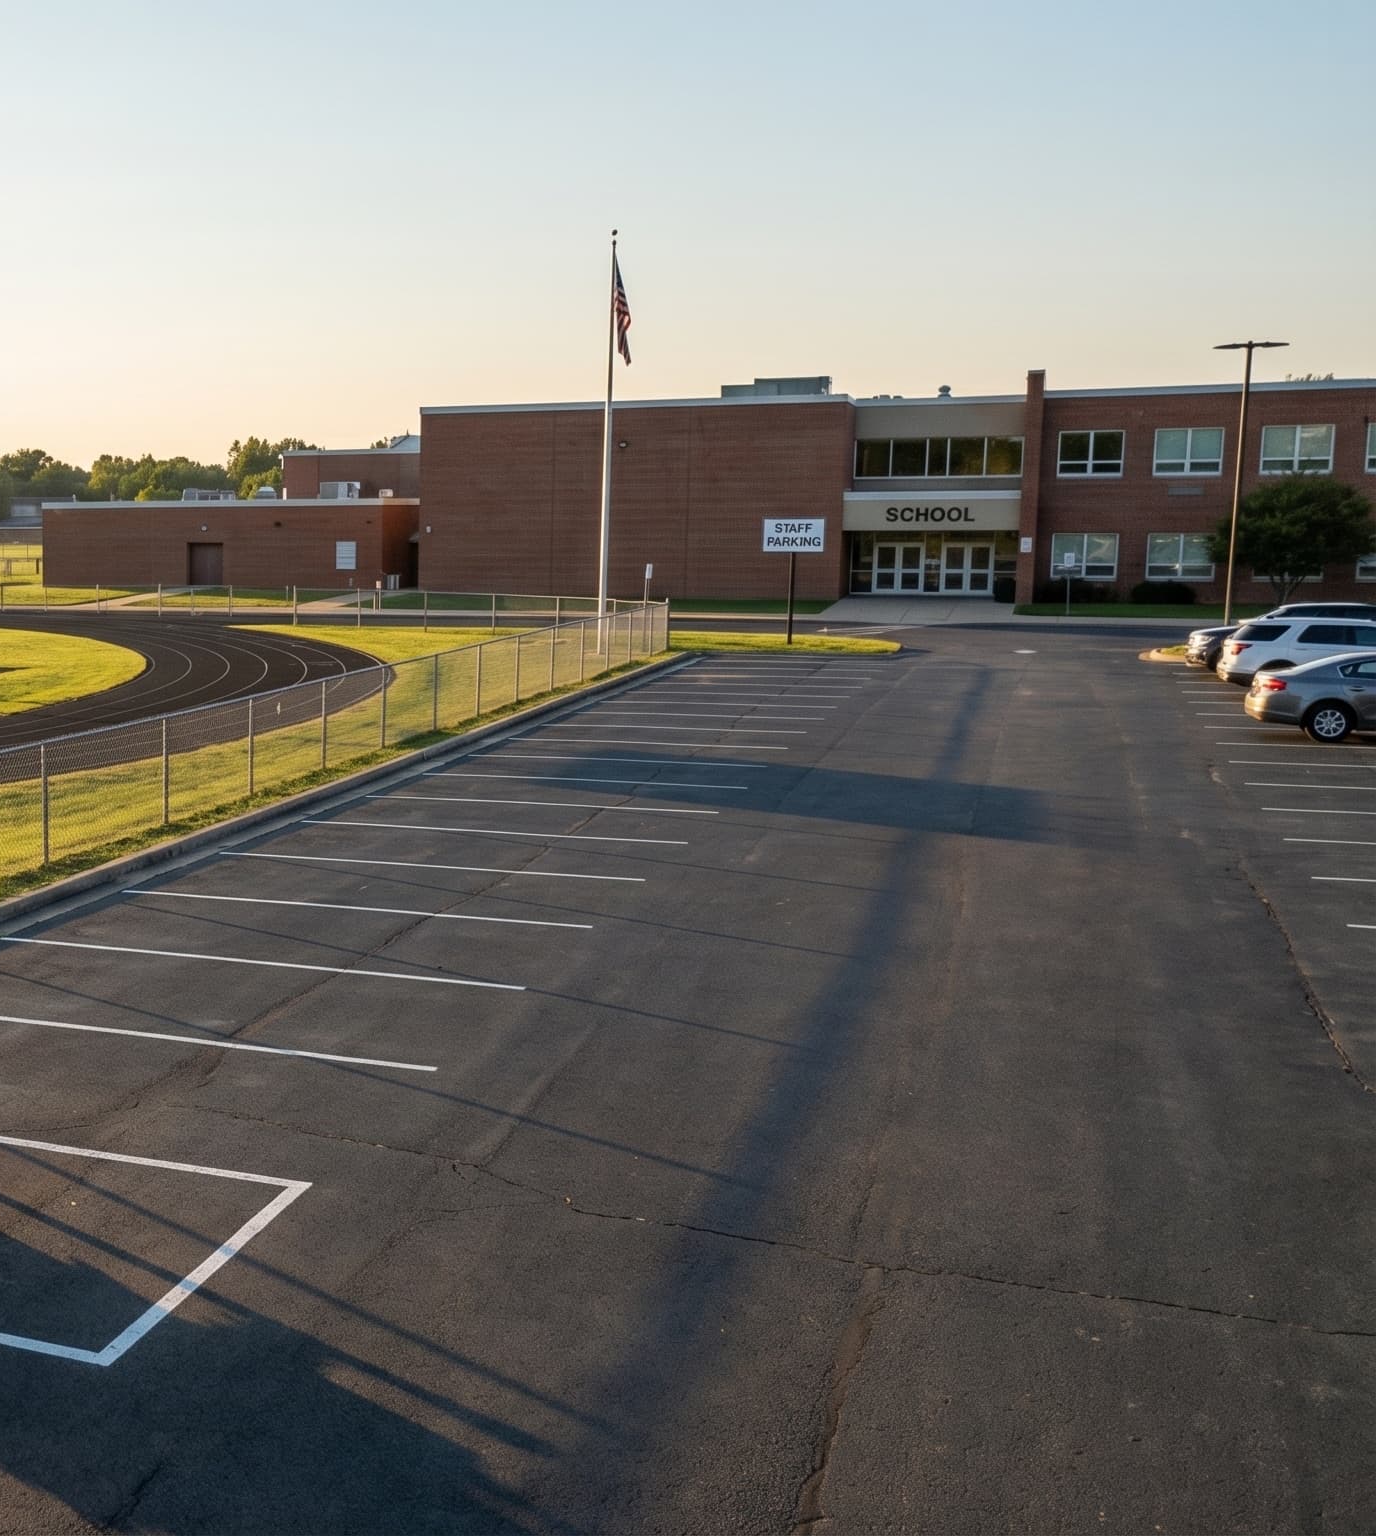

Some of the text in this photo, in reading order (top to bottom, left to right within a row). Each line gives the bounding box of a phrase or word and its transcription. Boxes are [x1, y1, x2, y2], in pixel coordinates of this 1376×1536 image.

[886, 507, 975, 522] SCHOOL
[775, 523, 813, 533] STAFF
[767, 536, 821, 547] PARKING
